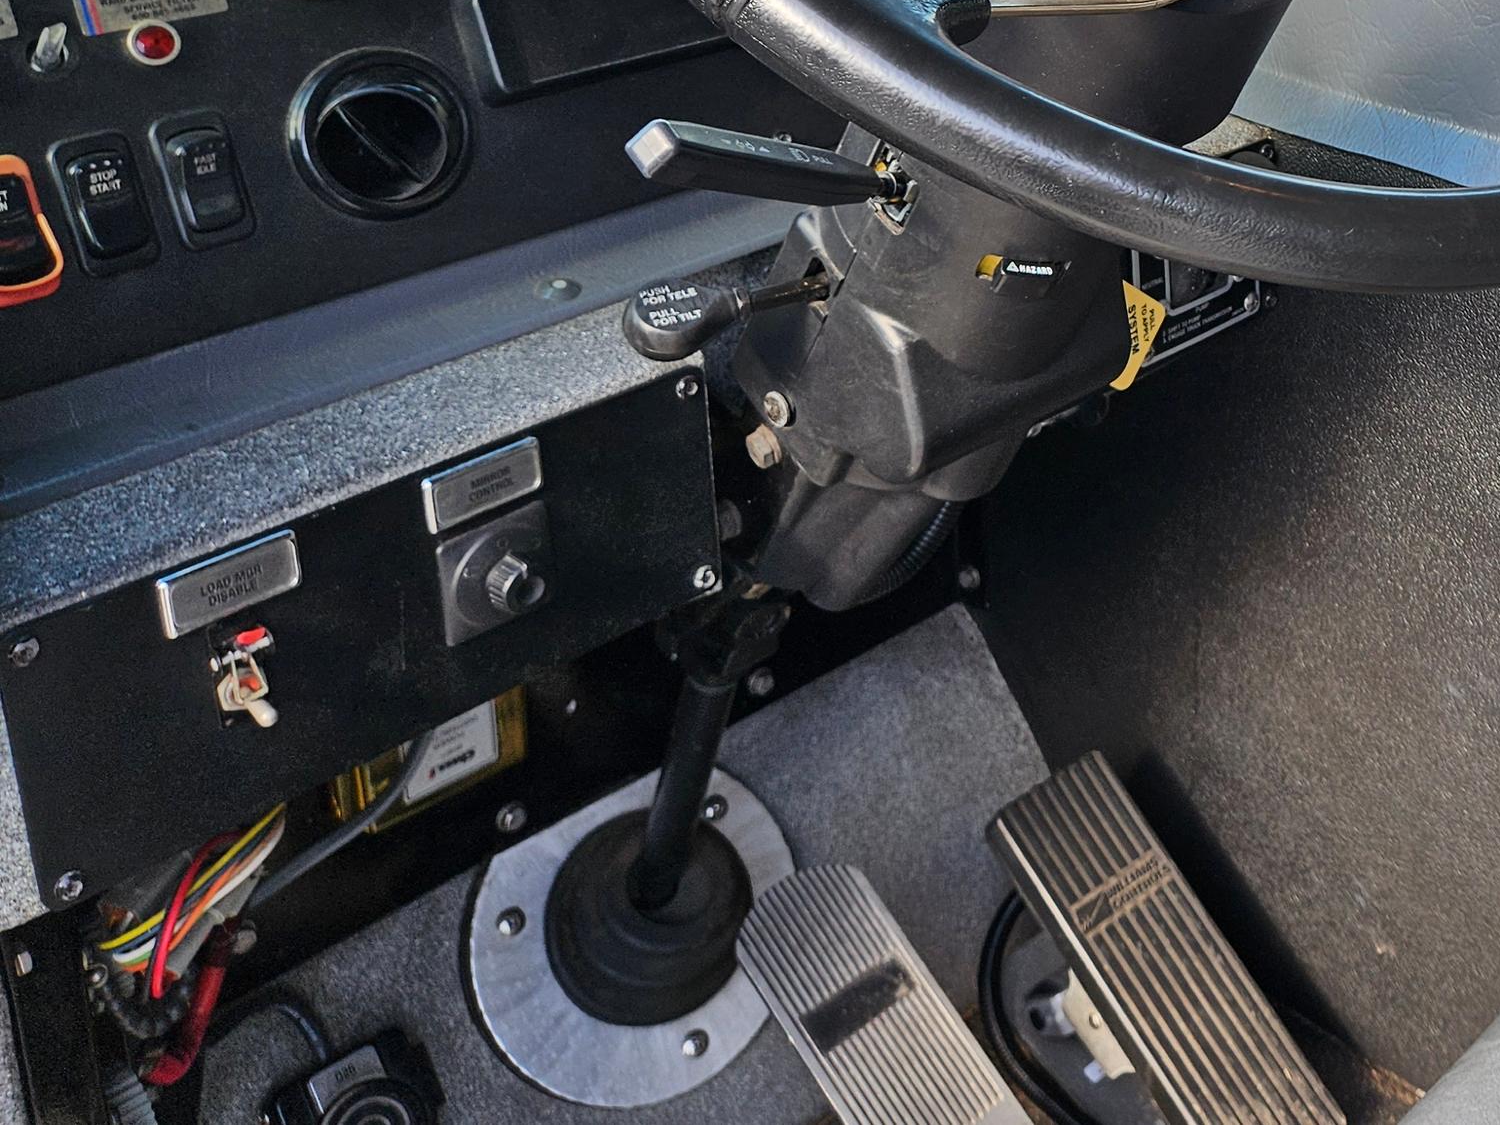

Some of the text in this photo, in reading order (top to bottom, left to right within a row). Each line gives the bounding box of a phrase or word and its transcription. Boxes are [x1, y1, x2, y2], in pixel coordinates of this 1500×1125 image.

[90, 169, 117, 184] STOP
[90, 179, 122, 196] START
[1019, 264, 1053, 275] HAZARD
[639, 285, 670, 298] PUSH
[642, 287, 698, 306] FOR TELE
[649, 308, 680, 320] PULL
[652, 309, 701, 327] FOR TILT
[1128, 304, 1140, 355] SYSTEM
[200, 576, 231, 597] LOAD
[208, 578, 258, 606] DISABLE
